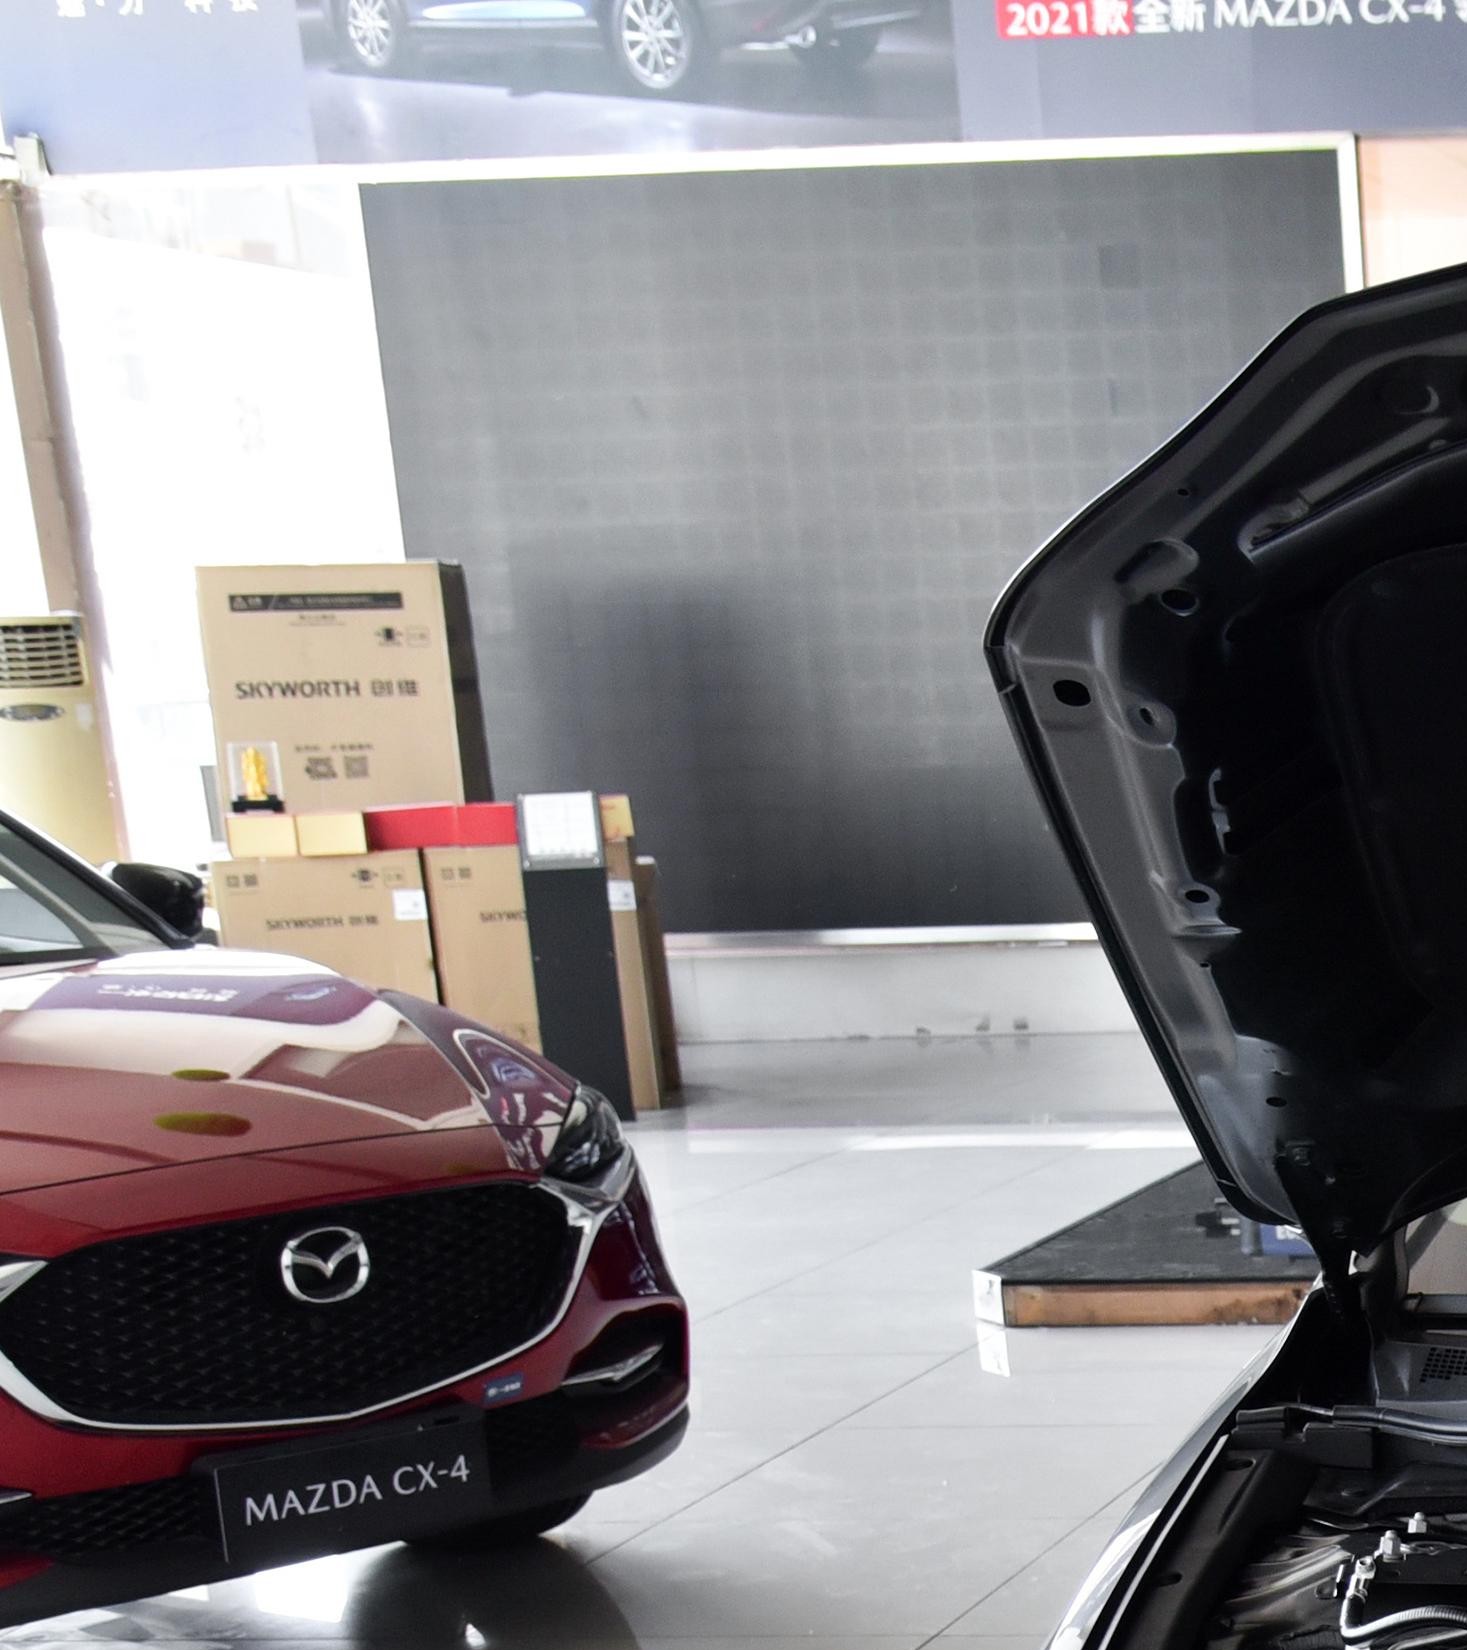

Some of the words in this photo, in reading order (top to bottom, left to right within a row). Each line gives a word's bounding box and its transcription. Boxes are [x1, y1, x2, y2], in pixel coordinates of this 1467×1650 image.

[1214, 0, 1352, 28] MAZDA
[1359, 0, 1446, 24] CX-4
[235, 680, 360, 700] SKYWORTH
[245, 1474, 383, 1526] MAZDA
[392, 1454, 470, 1495] CX-4
